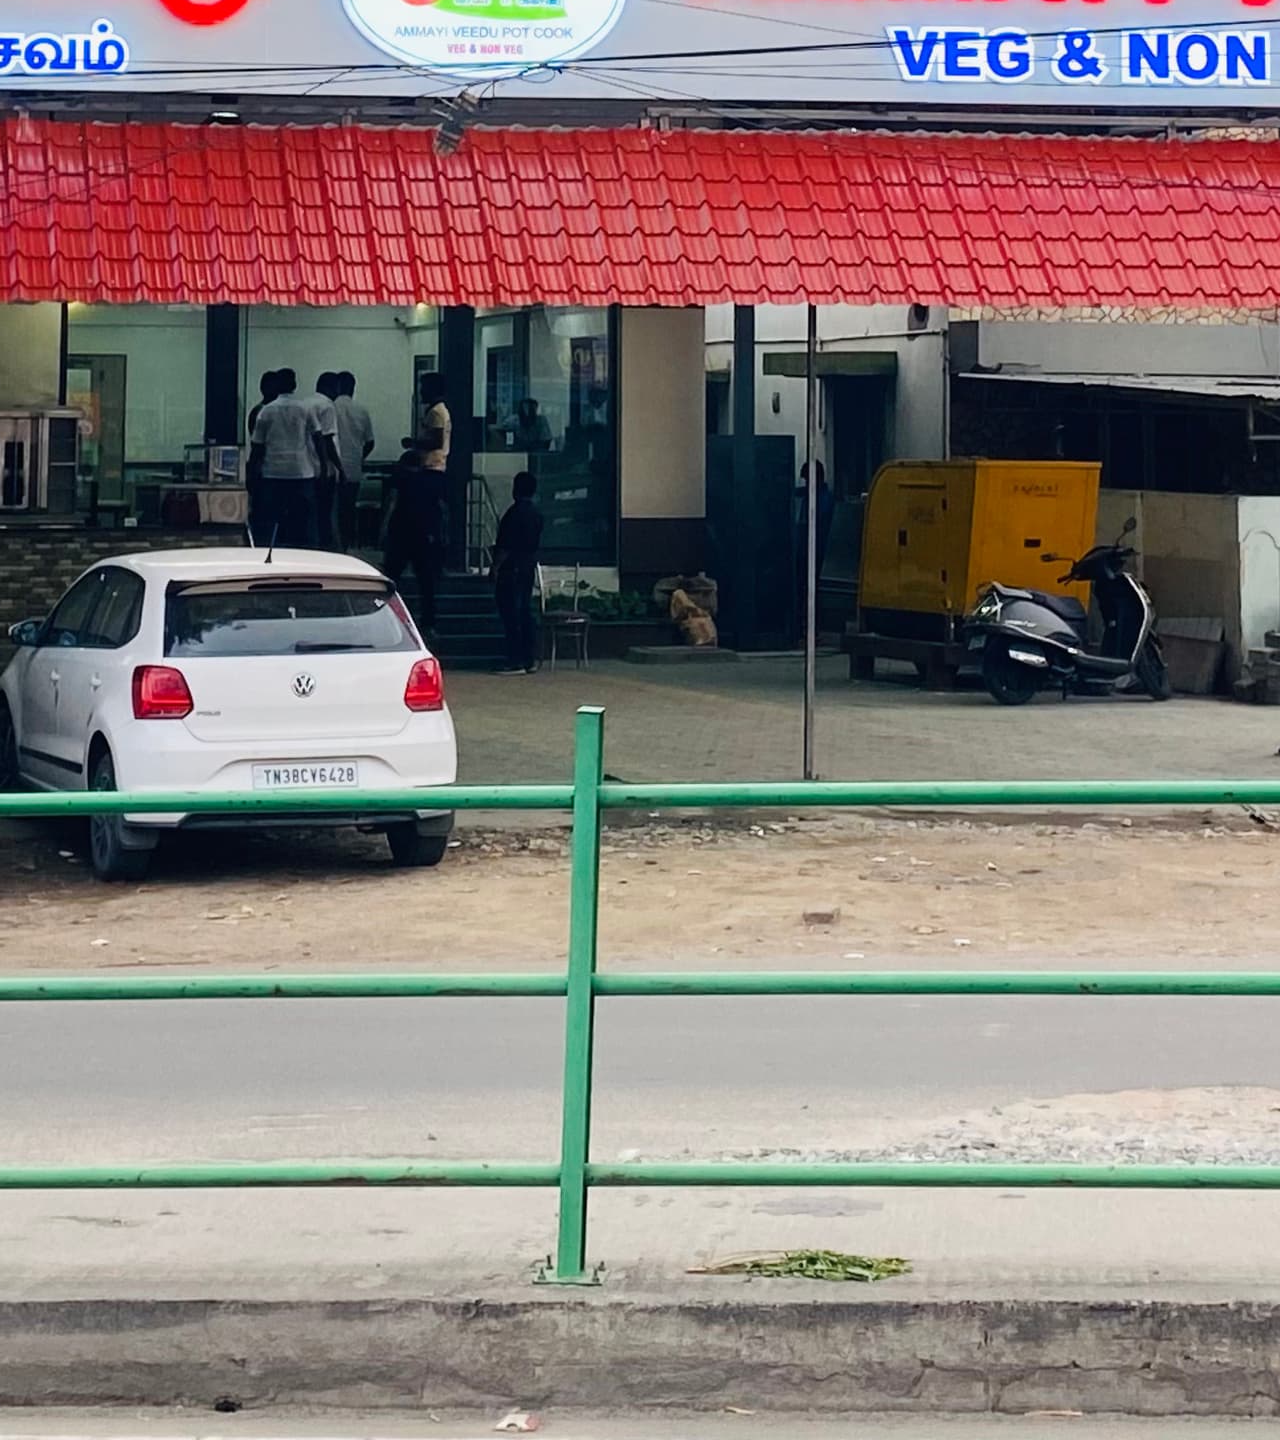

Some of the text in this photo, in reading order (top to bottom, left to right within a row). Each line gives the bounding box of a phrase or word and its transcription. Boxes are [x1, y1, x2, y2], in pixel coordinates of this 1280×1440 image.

[394, 26, 573, 39] AMMAYI VEEDU POT COOK
[447, 44, 466, 54] VEG
[480, 44, 501, 54] NON
[504, 44, 523, 55] VEG
[896, 31, 1030, 78] VEG
[1058, 30, 1102, 78] &
[1128, 32, 1268, 81] NON
